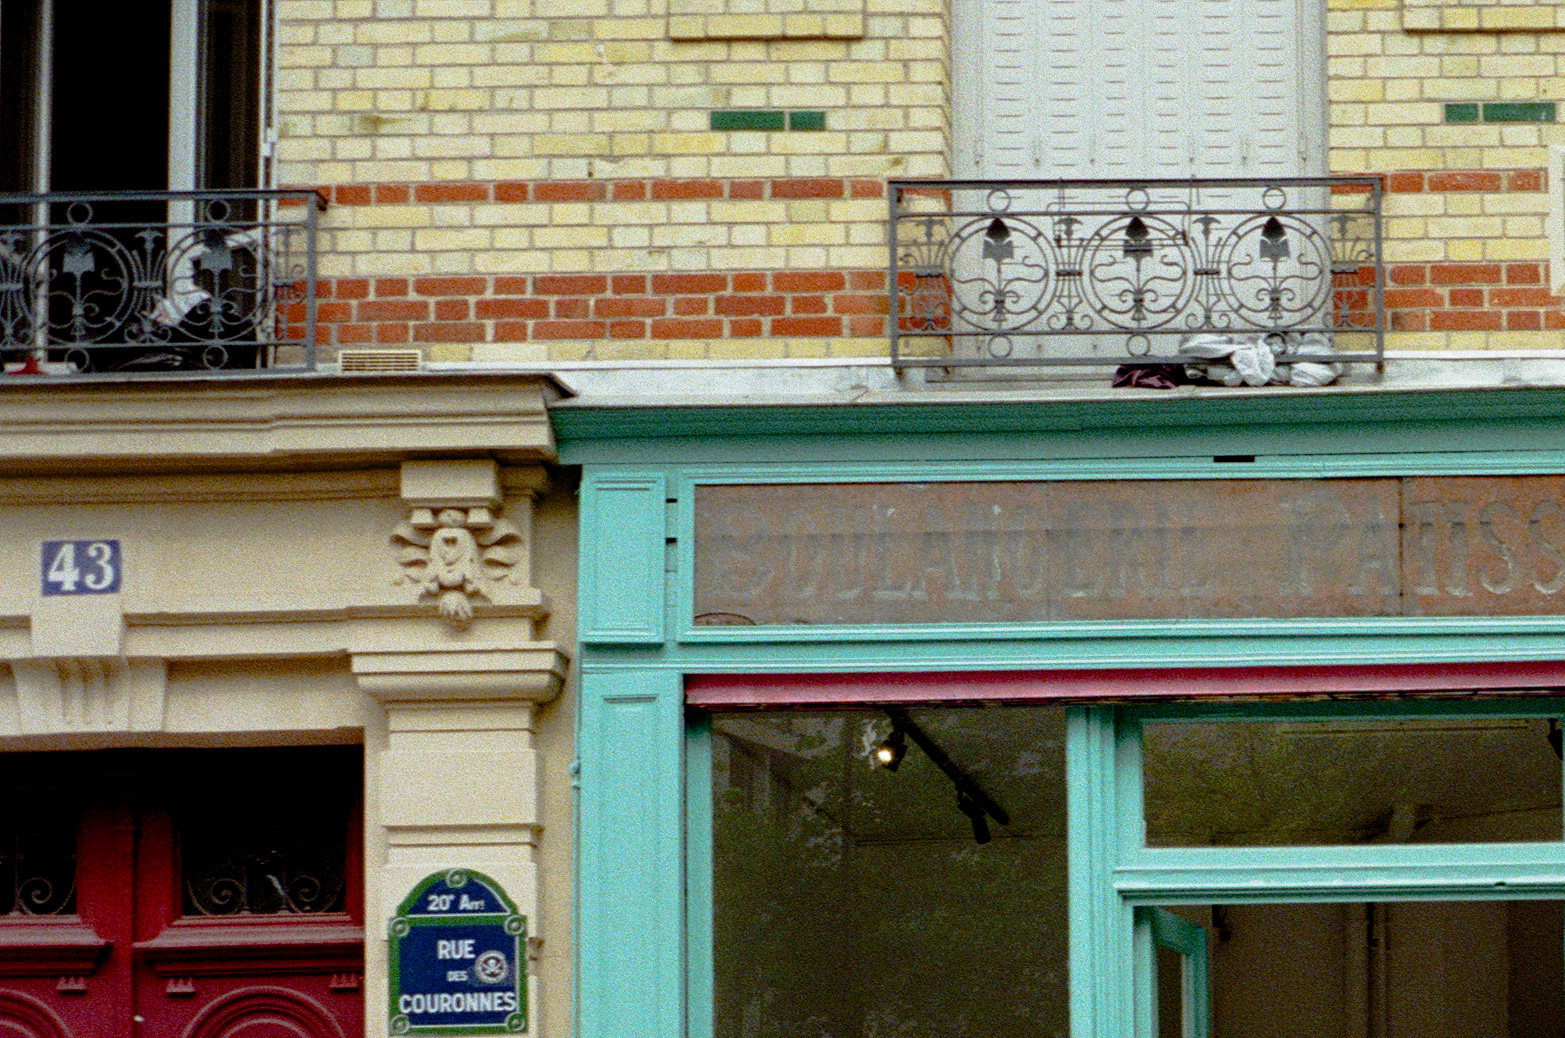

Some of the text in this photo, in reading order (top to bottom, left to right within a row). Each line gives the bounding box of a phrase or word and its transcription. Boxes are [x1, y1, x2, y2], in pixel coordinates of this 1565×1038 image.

[48, 543, 114, 590] 43
[437, 939, 476, 960] RUE
[446, 970, 469, 982] DES
[400, 992, 517, 1014] COURONNES
